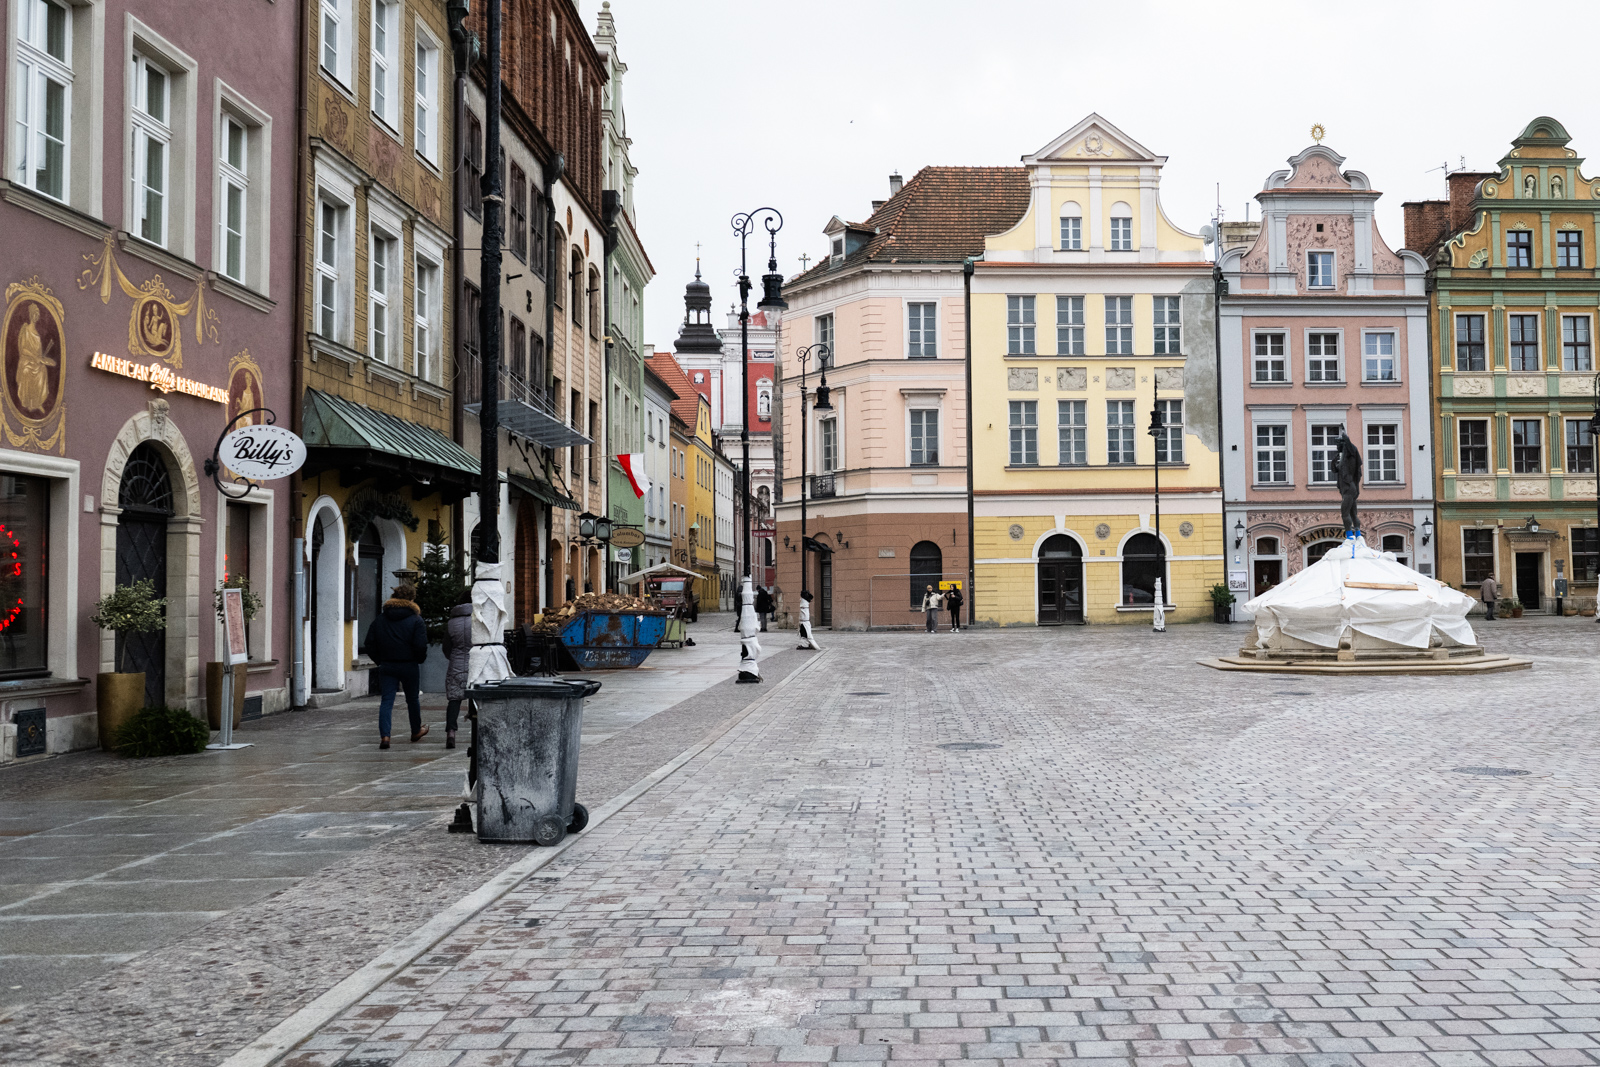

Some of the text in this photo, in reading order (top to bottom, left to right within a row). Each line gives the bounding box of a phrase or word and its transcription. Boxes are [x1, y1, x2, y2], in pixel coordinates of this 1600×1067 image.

[91, 352, 229, 404] AMERICAN Billy's RESTAURANTS
[231, 428, 294, 441] AMERICAN
[233, 436, 293, 469] Billy's
